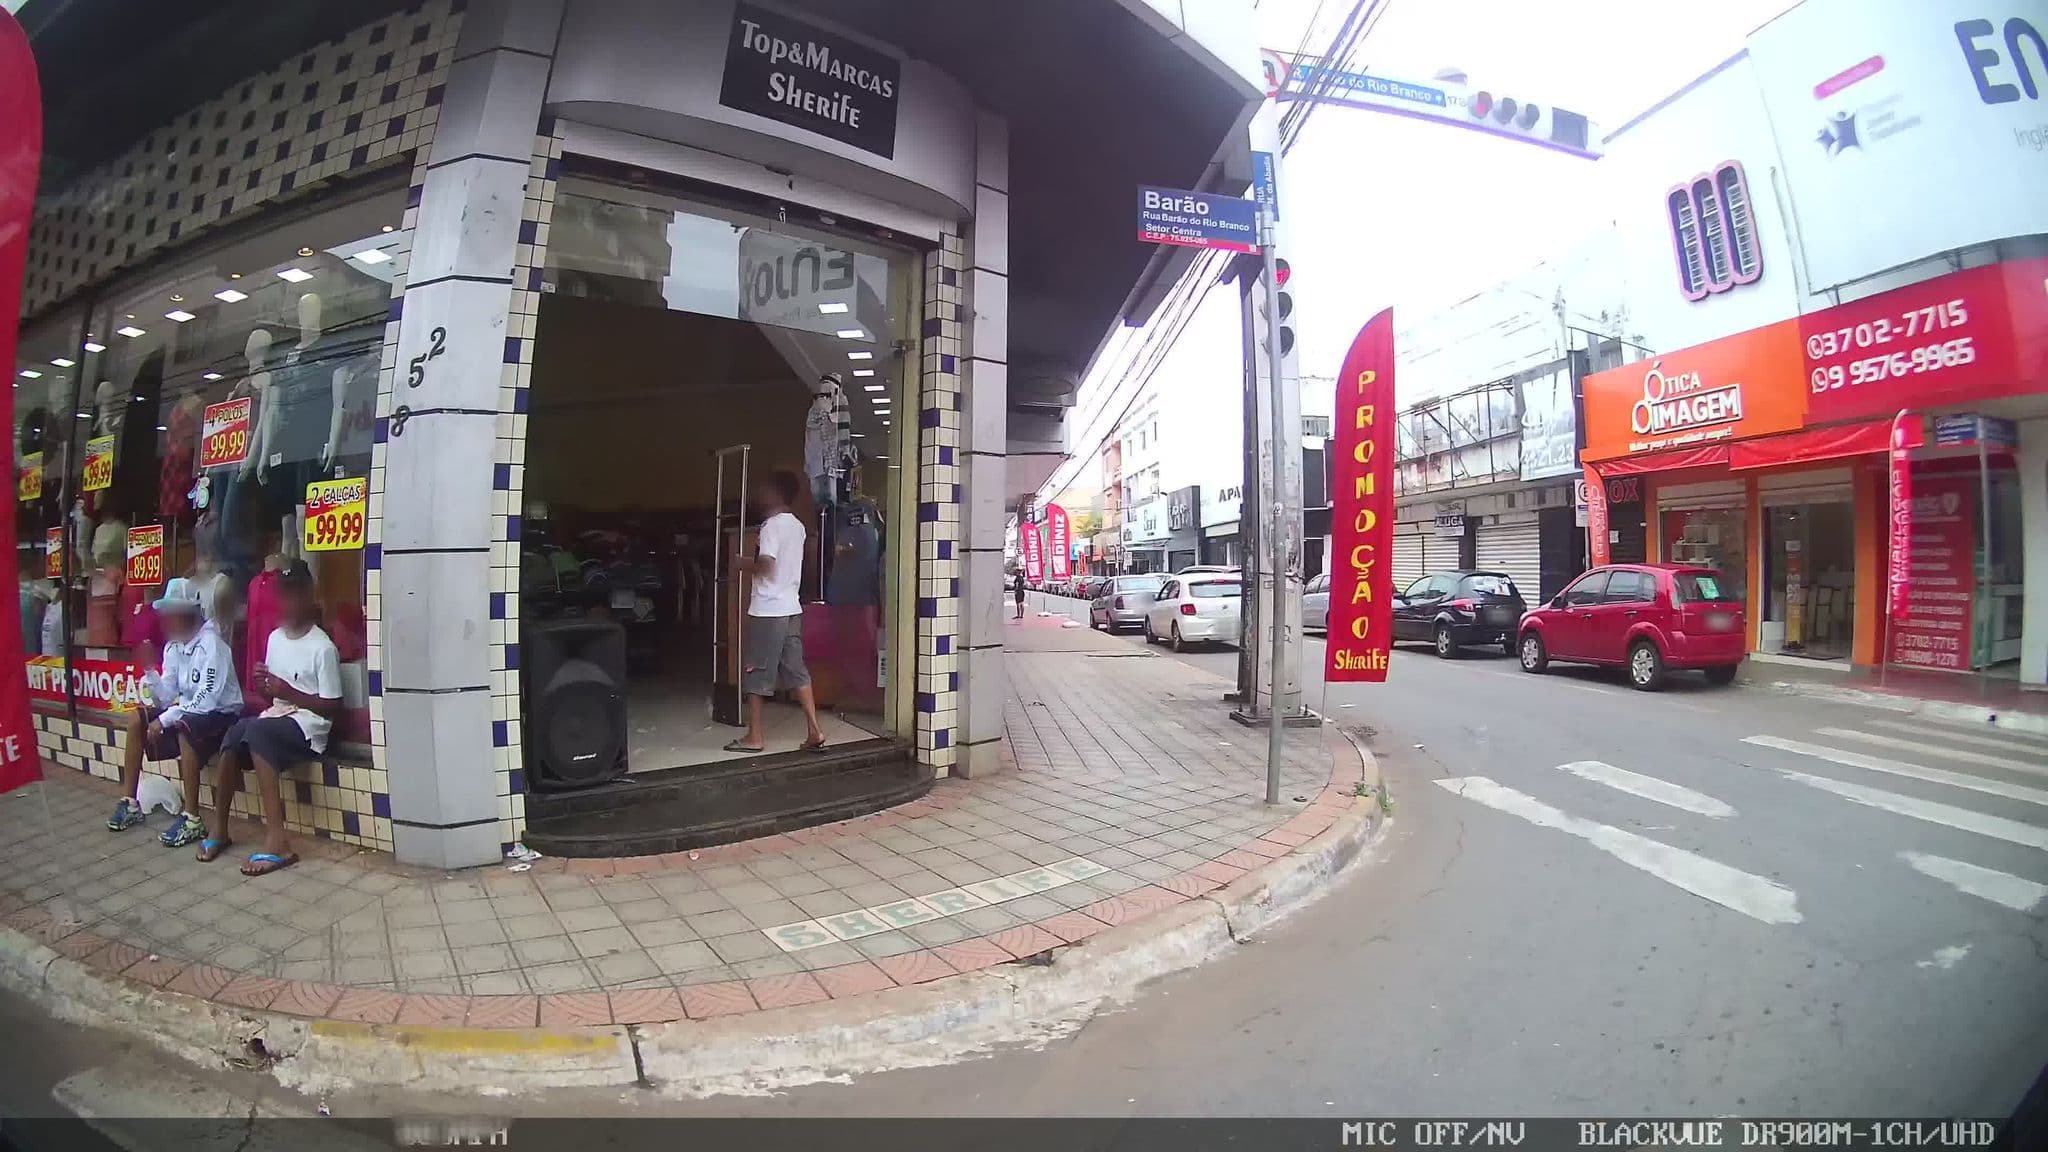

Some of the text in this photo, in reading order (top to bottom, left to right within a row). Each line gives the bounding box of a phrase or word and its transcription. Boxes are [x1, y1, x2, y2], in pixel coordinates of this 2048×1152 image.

[1367, 80, 1387, 94] Rio
[1391, 83, 1431, 101] Branco
[1145, 191, 1209, 215] Barão
[1143, 211, 1161, 221] Rua
[1162, 213, 1187, 224] Barão
[1203, 218, 1217, 227] Rio
[1220, 220, 1249, 232] Branco
[1146, 223, 1170, 233] Setor
[1823, 299, 1968, 356] 3702-7715
[1828, 337, 1976, 389] 9 9576-9965
[211, 430, 245, 459] 99,99
[310, 484, 361, 507] 2 CALÇAS
[1350, 370, 1376, 640] PROMOÇÃO
[316, 512, 362, 547] 99,99
[1055, 513, 1065, 556] DINIZ
[1028, 529, 1038, 562] DINIZ
[133, 555, 160, 580] 89,99
[206, 667, 216, 693] BMW
